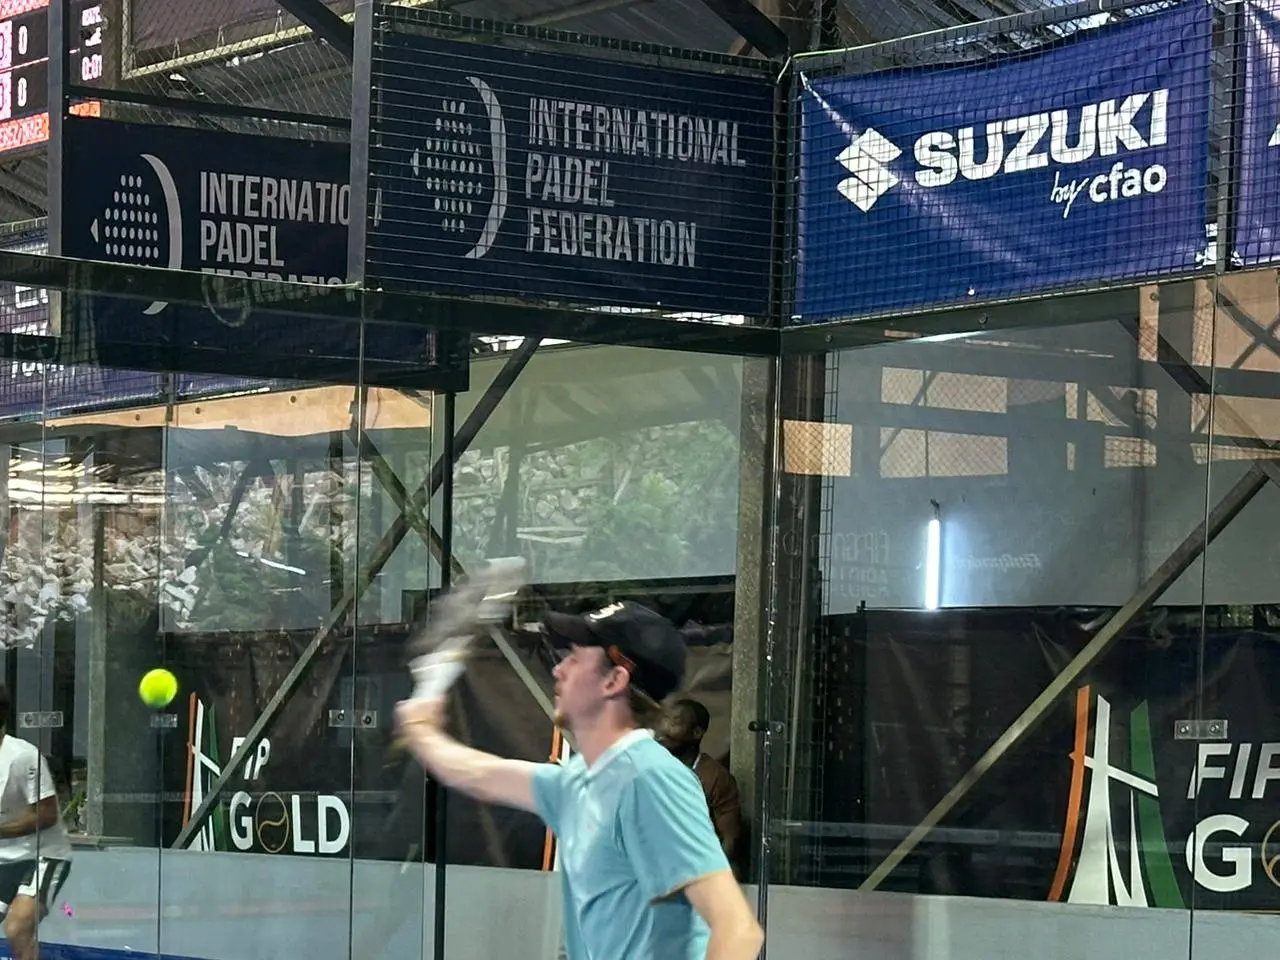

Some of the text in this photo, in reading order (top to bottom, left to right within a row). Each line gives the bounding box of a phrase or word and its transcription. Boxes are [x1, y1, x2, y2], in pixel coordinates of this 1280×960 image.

[18, 26, 28, 55] 0
[18, 78, 27, 107] 0
[528, 97, 746, 167] INTERNATIONAL
[914, 89, 1169, 188] SUZUKI
[200, 171, 382, 228] INTERNATIO
[525, 152, 615, 207] PADEL
[1050, 162, 1167, 218] by cfao
[200, 219, 285, 267] PADEL
[526, 207, 697, 268] FEDERATION
[229, 790, 350, 854] GOLD
